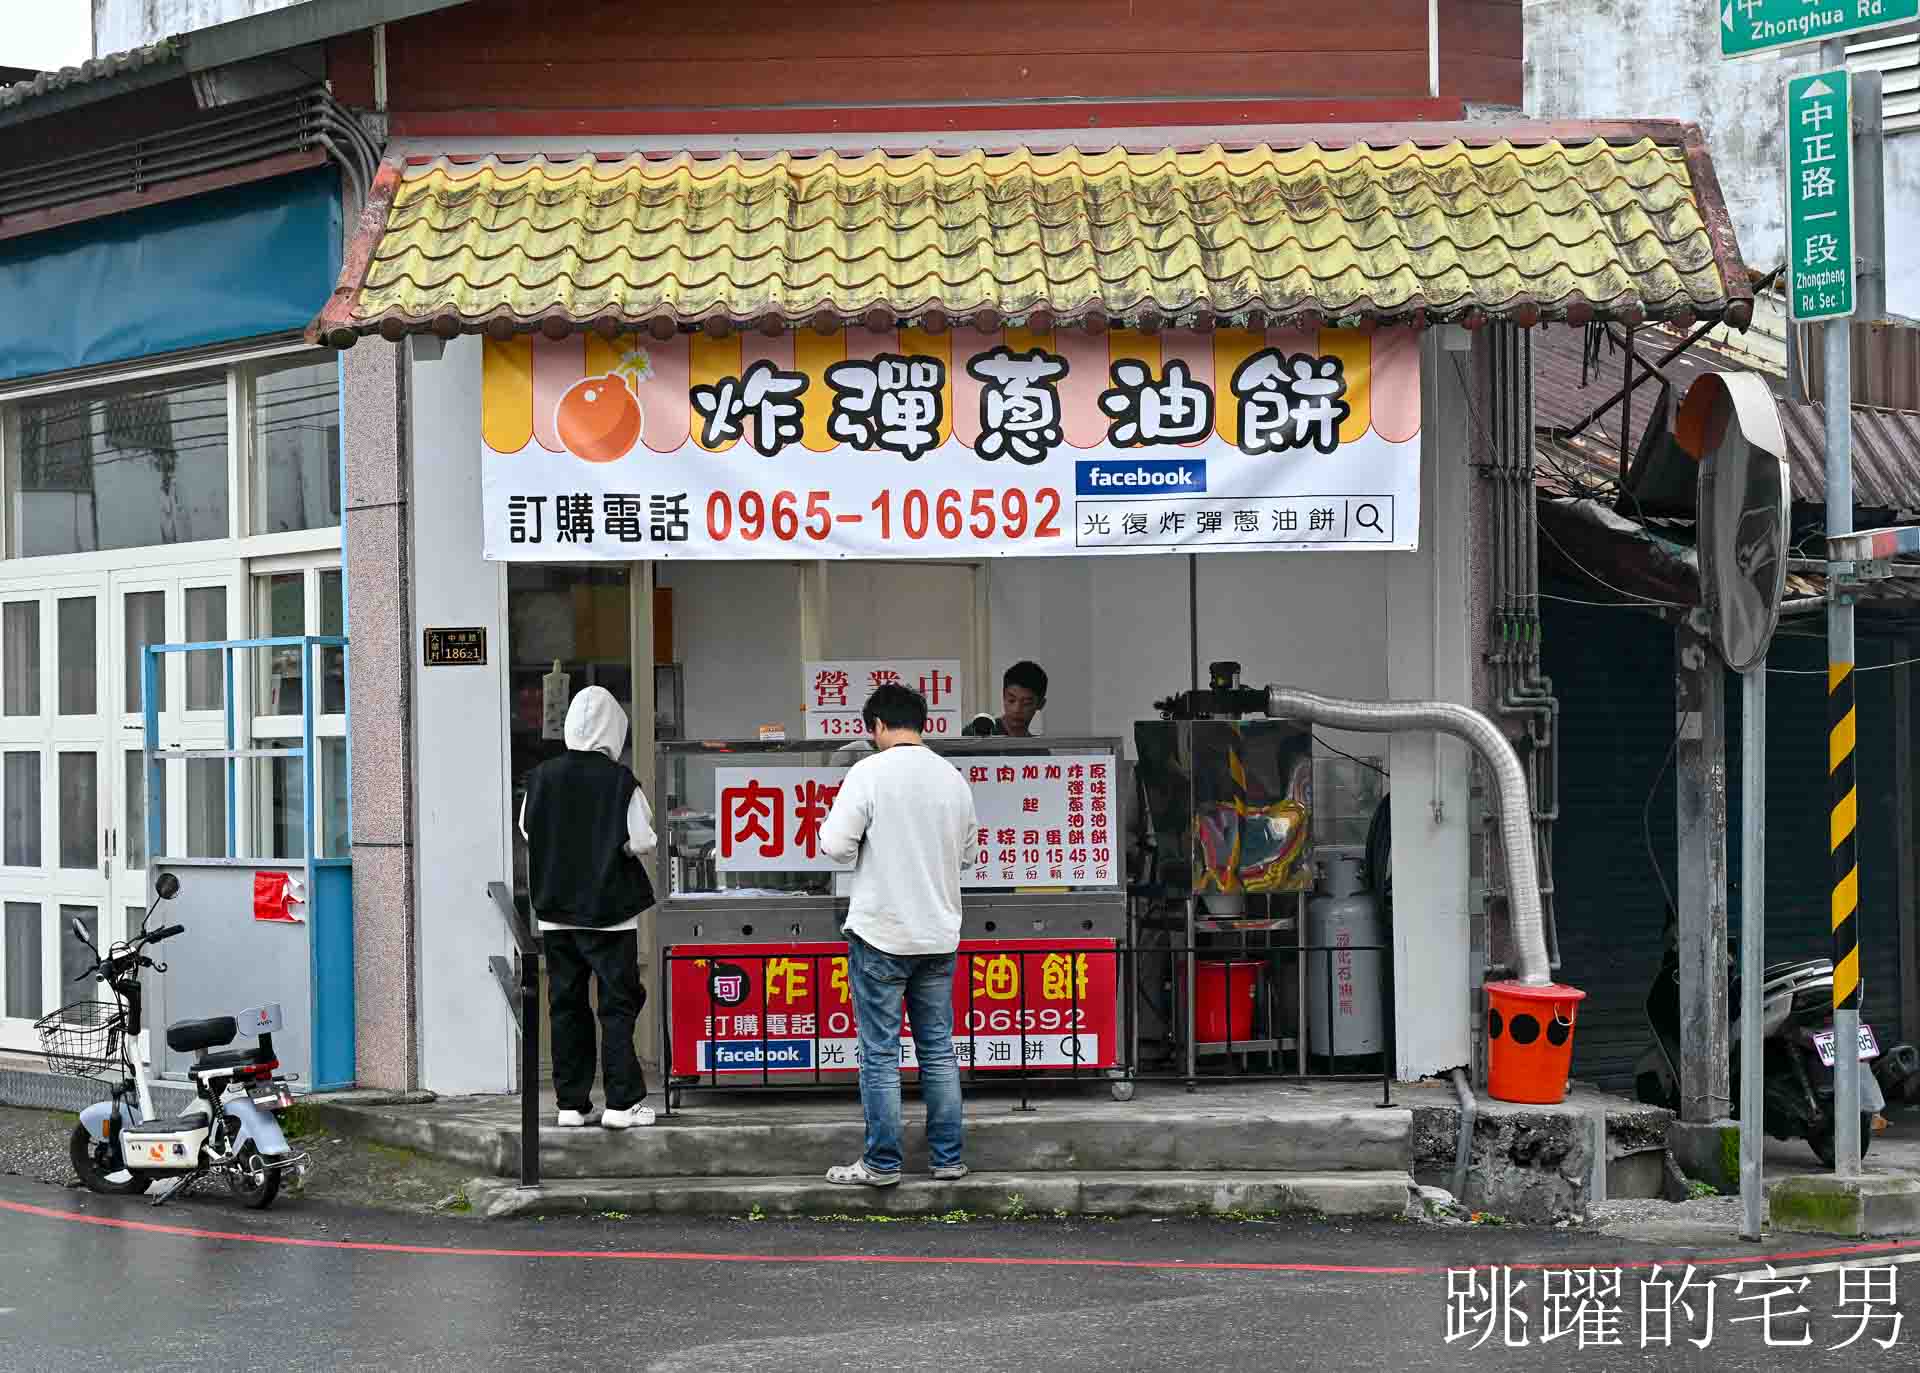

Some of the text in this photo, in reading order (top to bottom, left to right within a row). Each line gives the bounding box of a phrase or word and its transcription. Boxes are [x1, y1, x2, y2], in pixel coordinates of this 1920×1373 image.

[1751, 9, 1844, 40] Zhonghua
[1857, 0, 1886, 17] Rd.
[1800, 101, 1839, 266] 中正路一段
[1796, 268, 1845, 291] Zhongzheng
[1803, 295, 1817, 312] Rd.
[1819, 292, 1839, 309] Sec.
[690, 346, 1350, 465] 炸彈蔥油餅
[1089, 467, 1192, 487] facebook
[508, 487, 1061, 543] 訂購電話 0965-106592
[1084, 508, 1336, 536] 光復炸彈蔥油餅
[704, 1013, 816, 1036] 訂購電話
[716, 1046, 799, 1064] facebook
